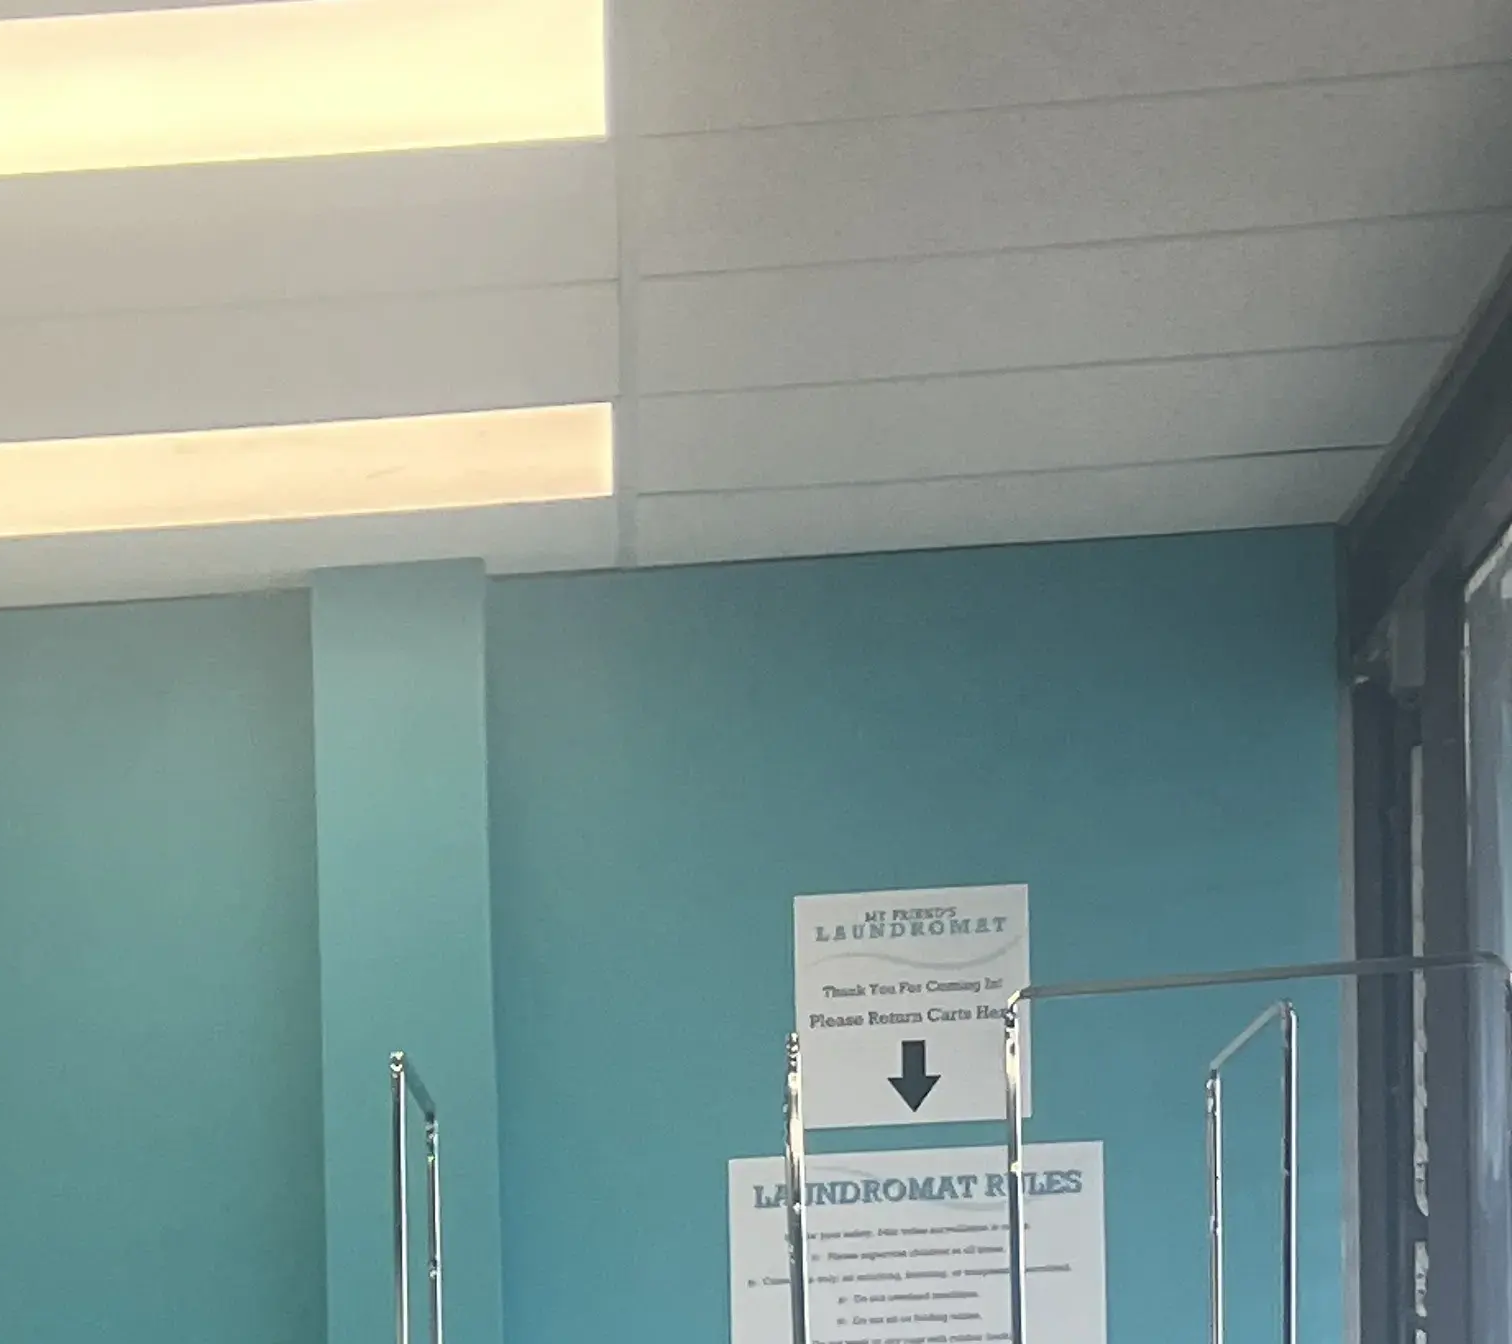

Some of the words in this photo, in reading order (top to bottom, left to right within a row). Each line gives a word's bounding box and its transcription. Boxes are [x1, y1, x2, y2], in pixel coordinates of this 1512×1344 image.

[815, 916, 1008, 943] LAUNDROMAT
[822, 984, 867, 999] Thank
[869, 982, 898, 996] You
[899, 980, 923, 994] For
[808, 1013, 865, 1029] Please
[867, 1009, 924, 1026] Return
[926, 1006, 972, 1023] Carts
[975, 1003, 1007, 1021] Her
